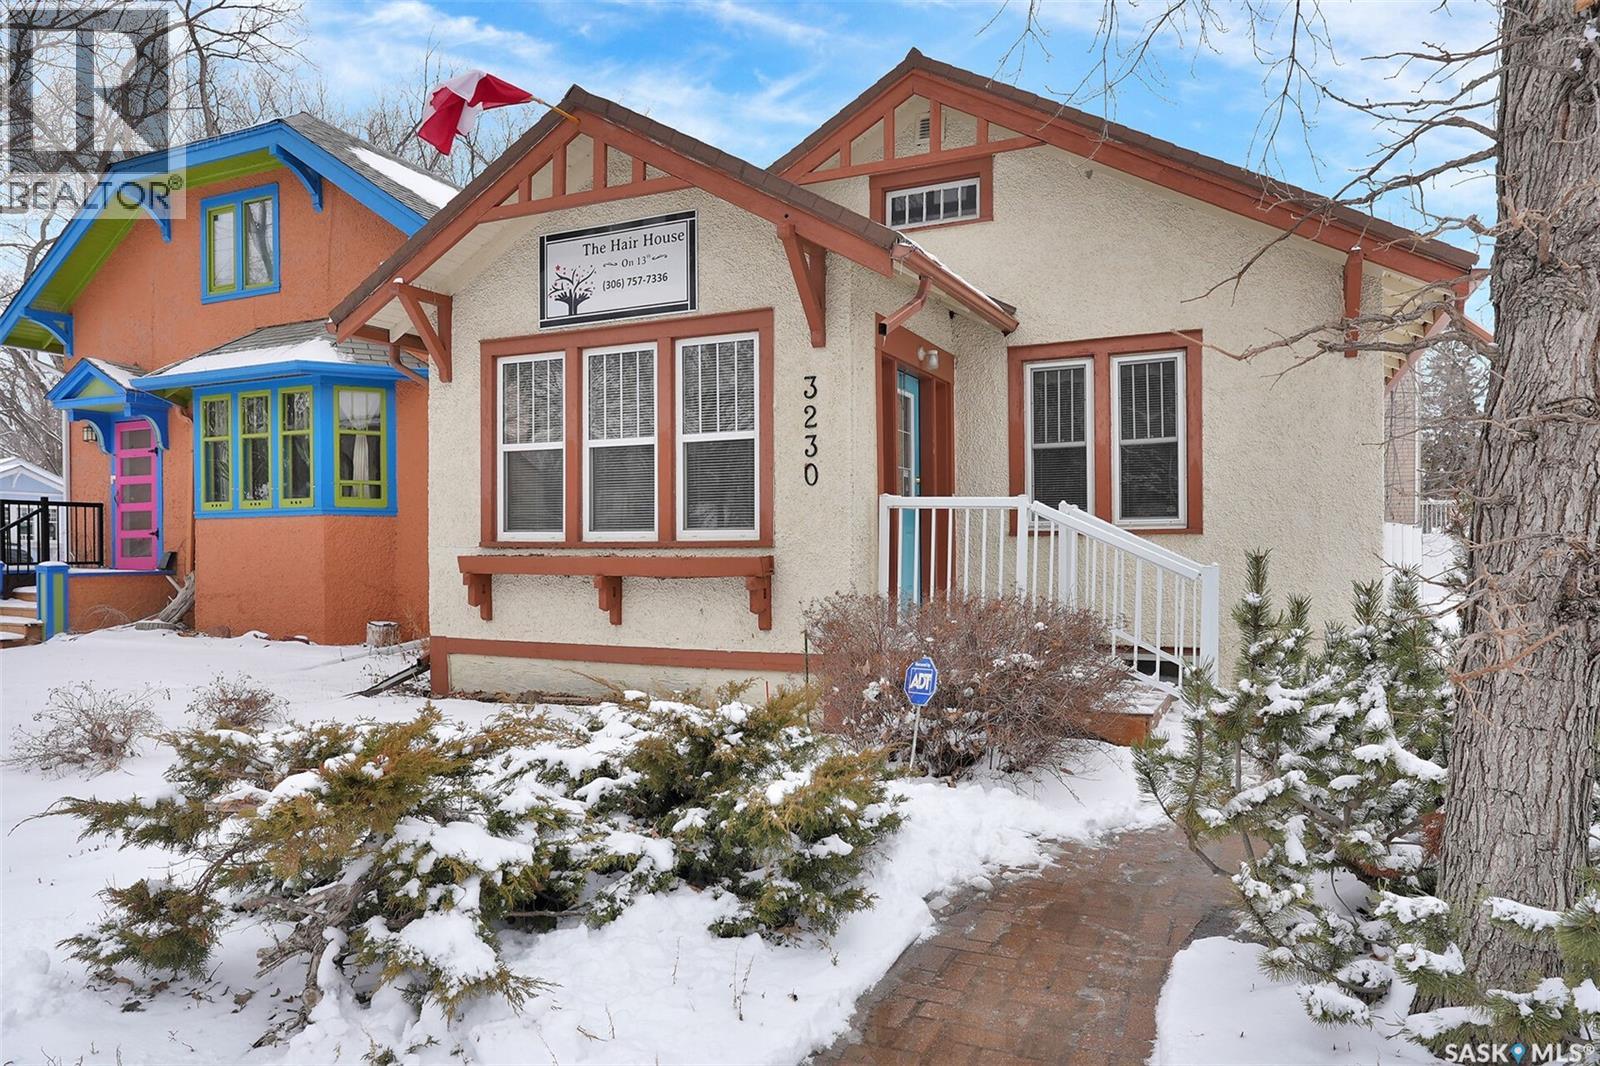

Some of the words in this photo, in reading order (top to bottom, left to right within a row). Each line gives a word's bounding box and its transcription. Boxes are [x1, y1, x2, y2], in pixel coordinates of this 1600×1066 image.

[582, 243, 607, 256] The
[610, 236, 639, 252] Hair
[643, 231, 685, 247] House
[621, 258, 634, 268] On
[602, 278, 625, 291] (306)
[627, 272, 668, 287] 757-7336
[803, 375, 818, 486] 3230
[909, 672, 932, 691] ADT
